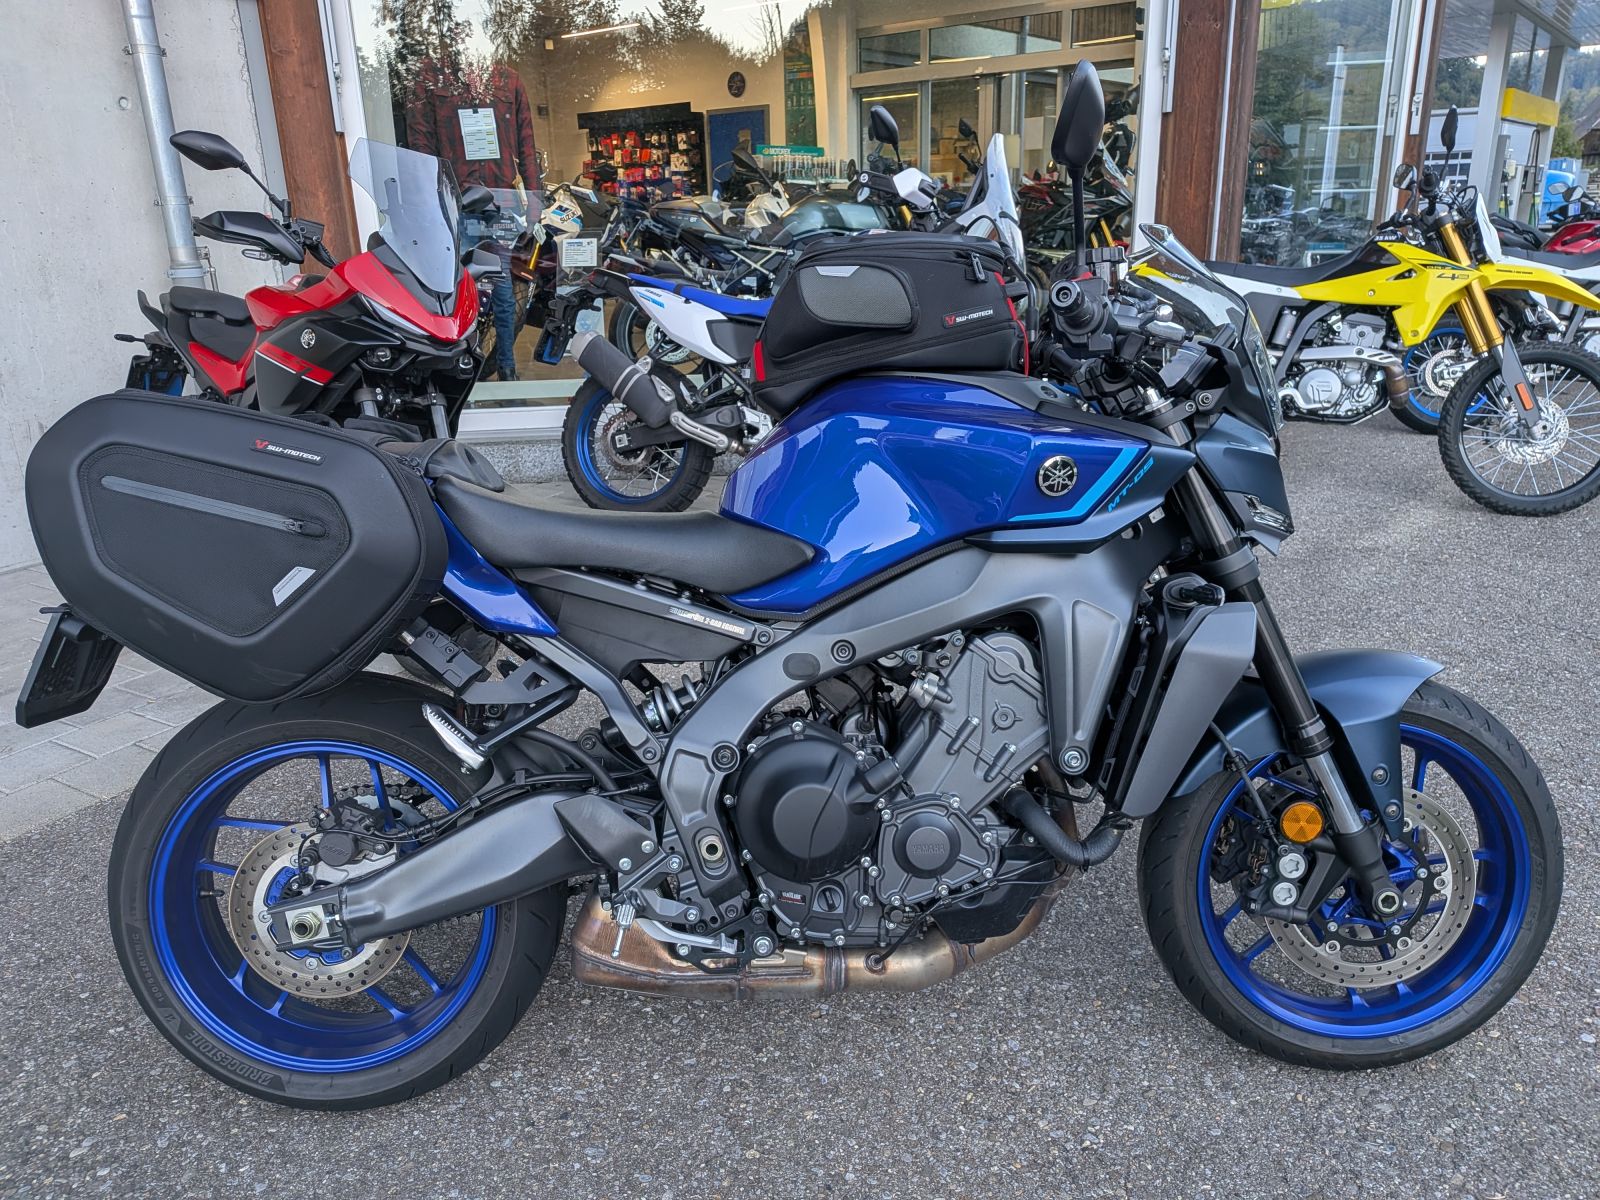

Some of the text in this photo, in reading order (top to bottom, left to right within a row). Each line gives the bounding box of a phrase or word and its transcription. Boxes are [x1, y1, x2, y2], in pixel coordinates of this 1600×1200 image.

[955, 309, 994, 323] SW-MOTECH
[266, 444, 321, 461] SW-MOTECH
[1108, 456, 1154, 513] MT-09
[912, 843, 945, 855] YAMAHA
[184, 1030, 274, 1085] BRIDGESTONE
